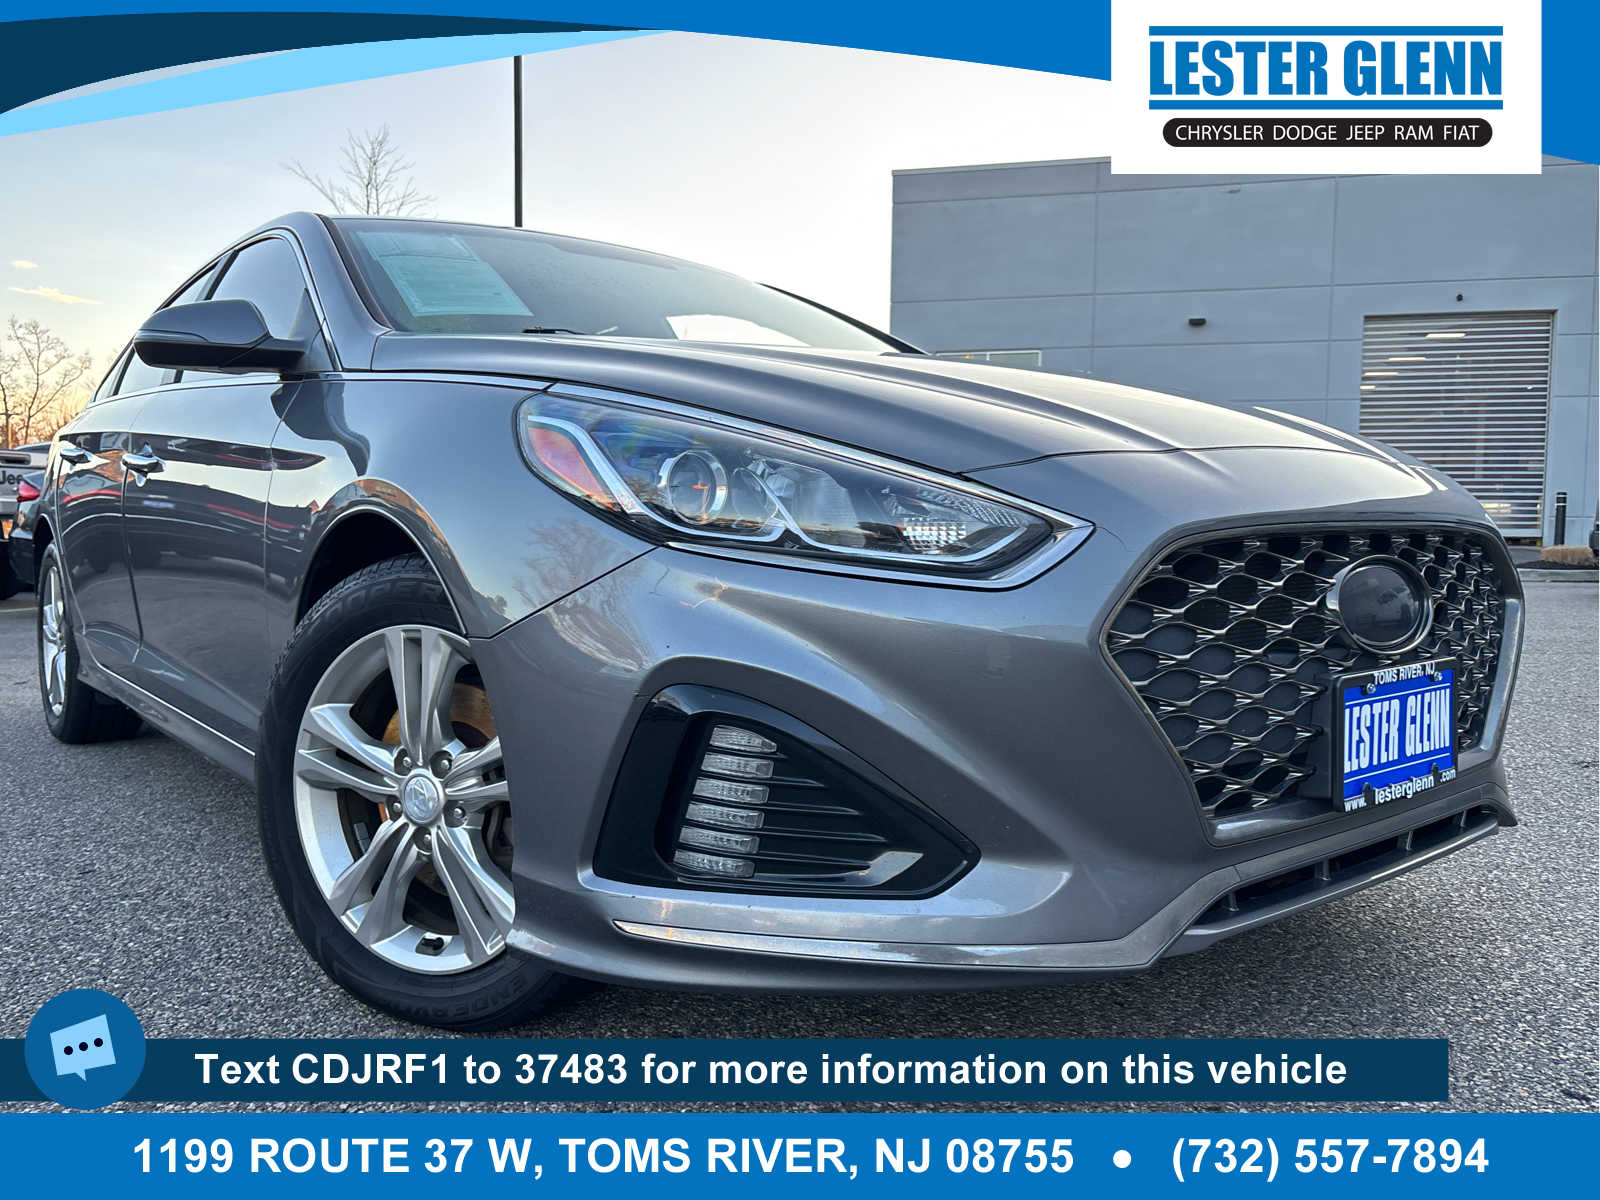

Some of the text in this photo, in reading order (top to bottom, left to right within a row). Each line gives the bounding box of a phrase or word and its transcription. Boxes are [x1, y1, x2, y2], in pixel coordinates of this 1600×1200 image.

[1373, 668, 1399, 686] TOMS
[1425, 662, 1436, 676] NJ
[1344, 688, 1450, 773] LESTER GLENN
[1344, 769, 1456, 812] www. lesterglenn .com
